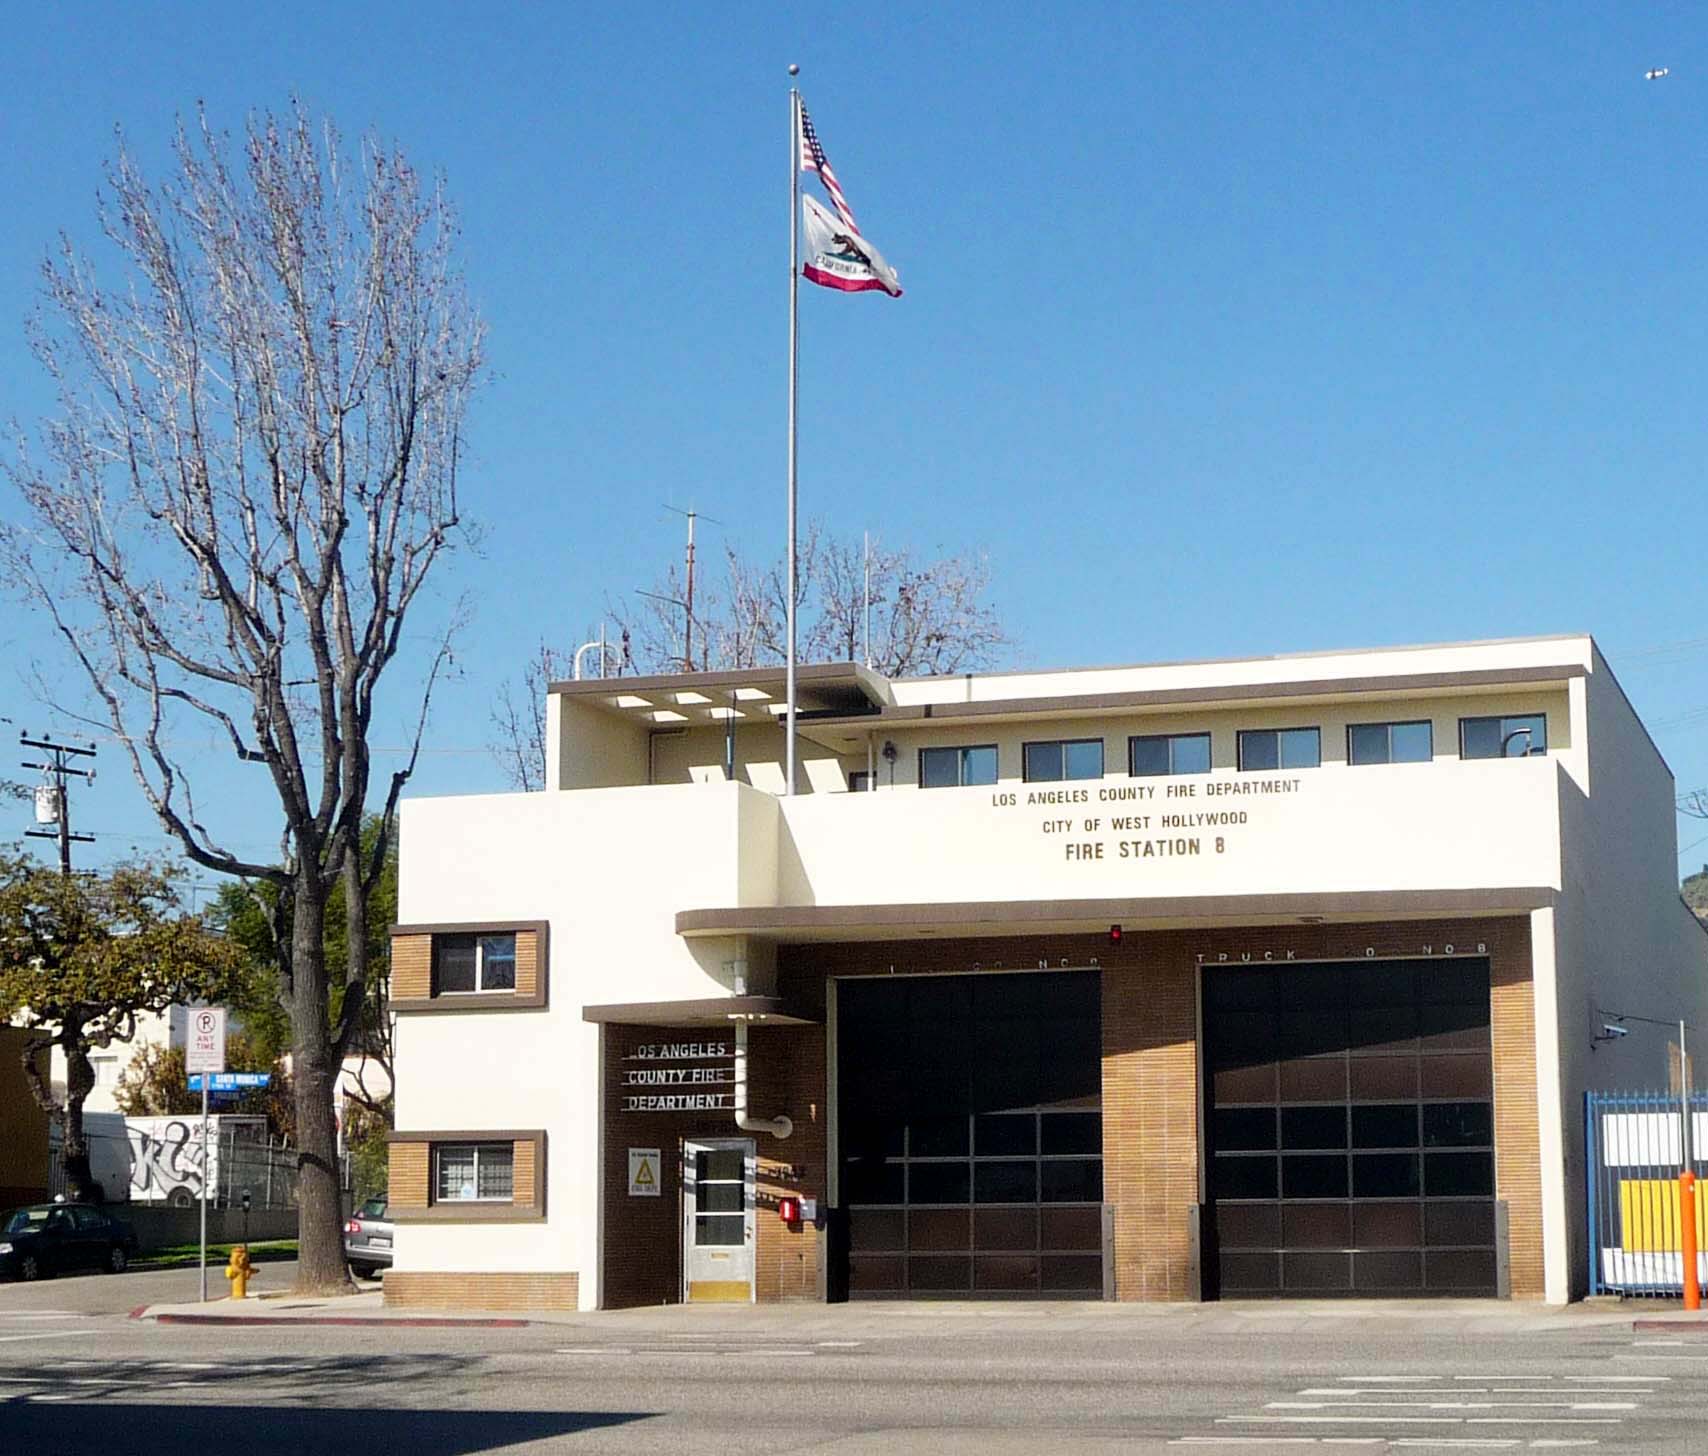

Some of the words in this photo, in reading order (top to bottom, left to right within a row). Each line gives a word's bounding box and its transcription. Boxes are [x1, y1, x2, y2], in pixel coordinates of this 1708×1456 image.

[992, 793, 1017, 807] LOS
[1027, 789, 1089, 805] ANGELES
[1098, 786, 1155, 802] COUNTY
[1166, 783, 1197, 799] FIRE
[1206, 779, 1301, 796] DEPARTMENT
[1042, 819, 1073, 834] CITY
[1084, 818, 1101, 832] OF
[1111, 816, 1151, 831] WEST
[1161, 811, 1248, 829] HOLLYWOOD
[1065, 842, 1104, 861] FIRE
[1119, 837, 1201, 859] STATION
[1196, 949, 1296, 963] TRUCK
[1423, 943, 1455, 955] NO
[196, 1042, 215, 1050] TIME
[660, 1042, 726, 1058] ANGELES
[628, 1069, 686, 1084] COUNTY
[691, 1068, 726, 1082] FIRE
[628, 1094, 725, 1110] DEPARTMENT
